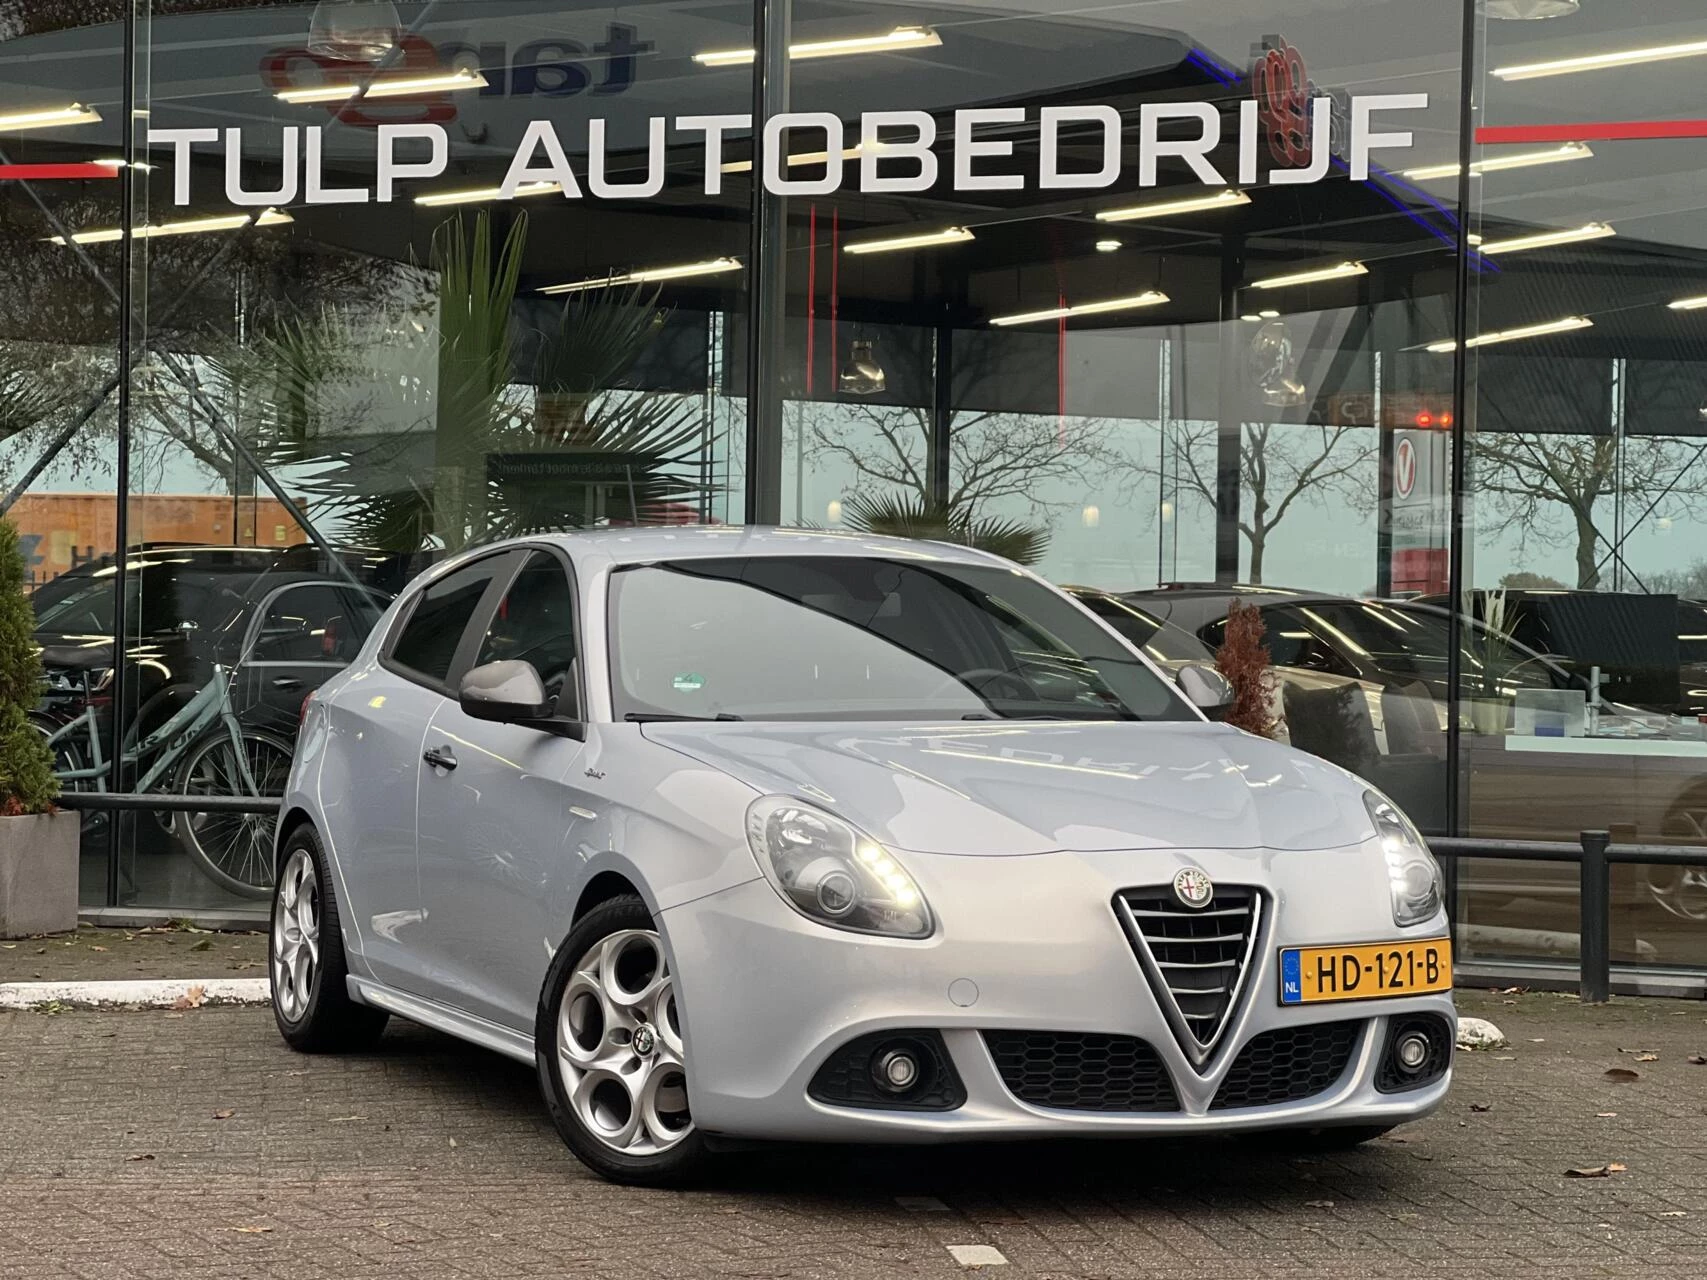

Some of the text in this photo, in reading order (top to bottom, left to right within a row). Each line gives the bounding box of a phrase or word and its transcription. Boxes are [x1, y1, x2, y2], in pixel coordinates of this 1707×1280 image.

[147, 92, 1429, 206] TULP AUTOBEDRIJF
[1285, 982, 1299, 993] NL
[1316, 948, 1440, 994] HD-121-B
